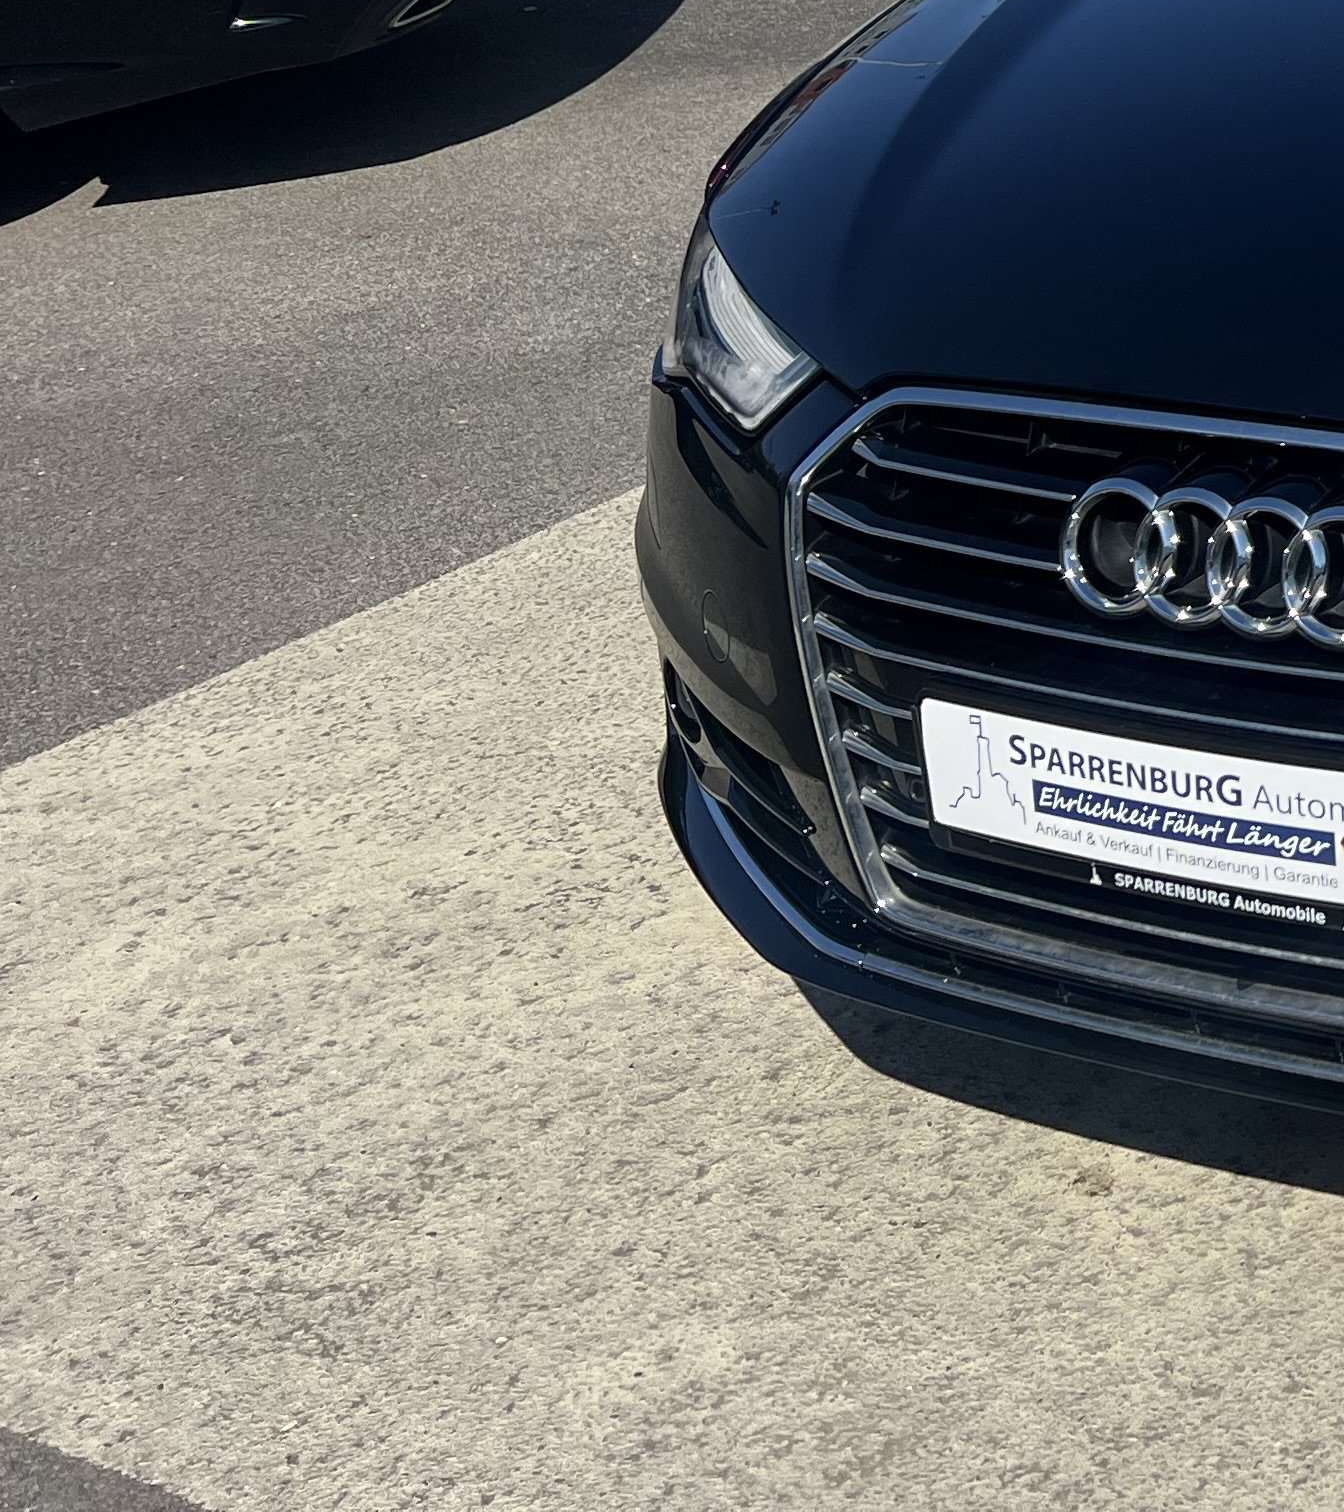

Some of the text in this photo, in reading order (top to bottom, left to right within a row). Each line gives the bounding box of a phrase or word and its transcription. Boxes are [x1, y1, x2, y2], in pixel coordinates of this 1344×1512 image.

[1009, 734, 1243, 806] SPARRENBURG
[1036, 821, 1339, 888] Ankauf & Verkauf Finanzierung Garantie
[1039, 787, 1331, 857] Ehrlichkeit Fährt Länger
[1115, 872, 1326, 925] SPARRENBURG Automobile
